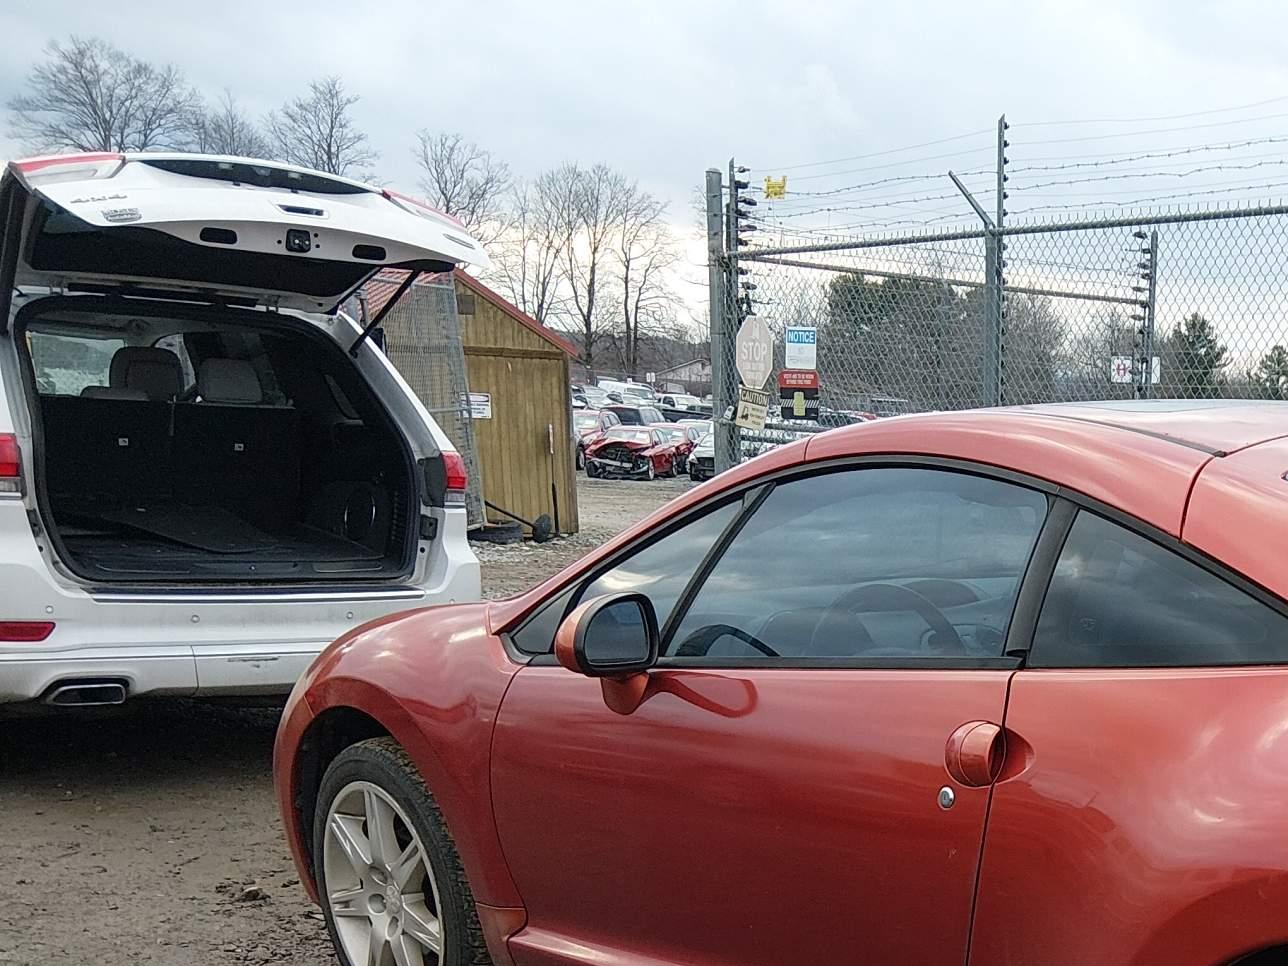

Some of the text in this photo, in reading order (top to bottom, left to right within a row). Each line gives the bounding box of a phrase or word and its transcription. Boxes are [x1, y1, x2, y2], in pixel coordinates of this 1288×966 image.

[788, 331, 815, 343] NOTICE
[742, 342, 767, 361] STOP
[741, 390, 768, 406] CAUTION
